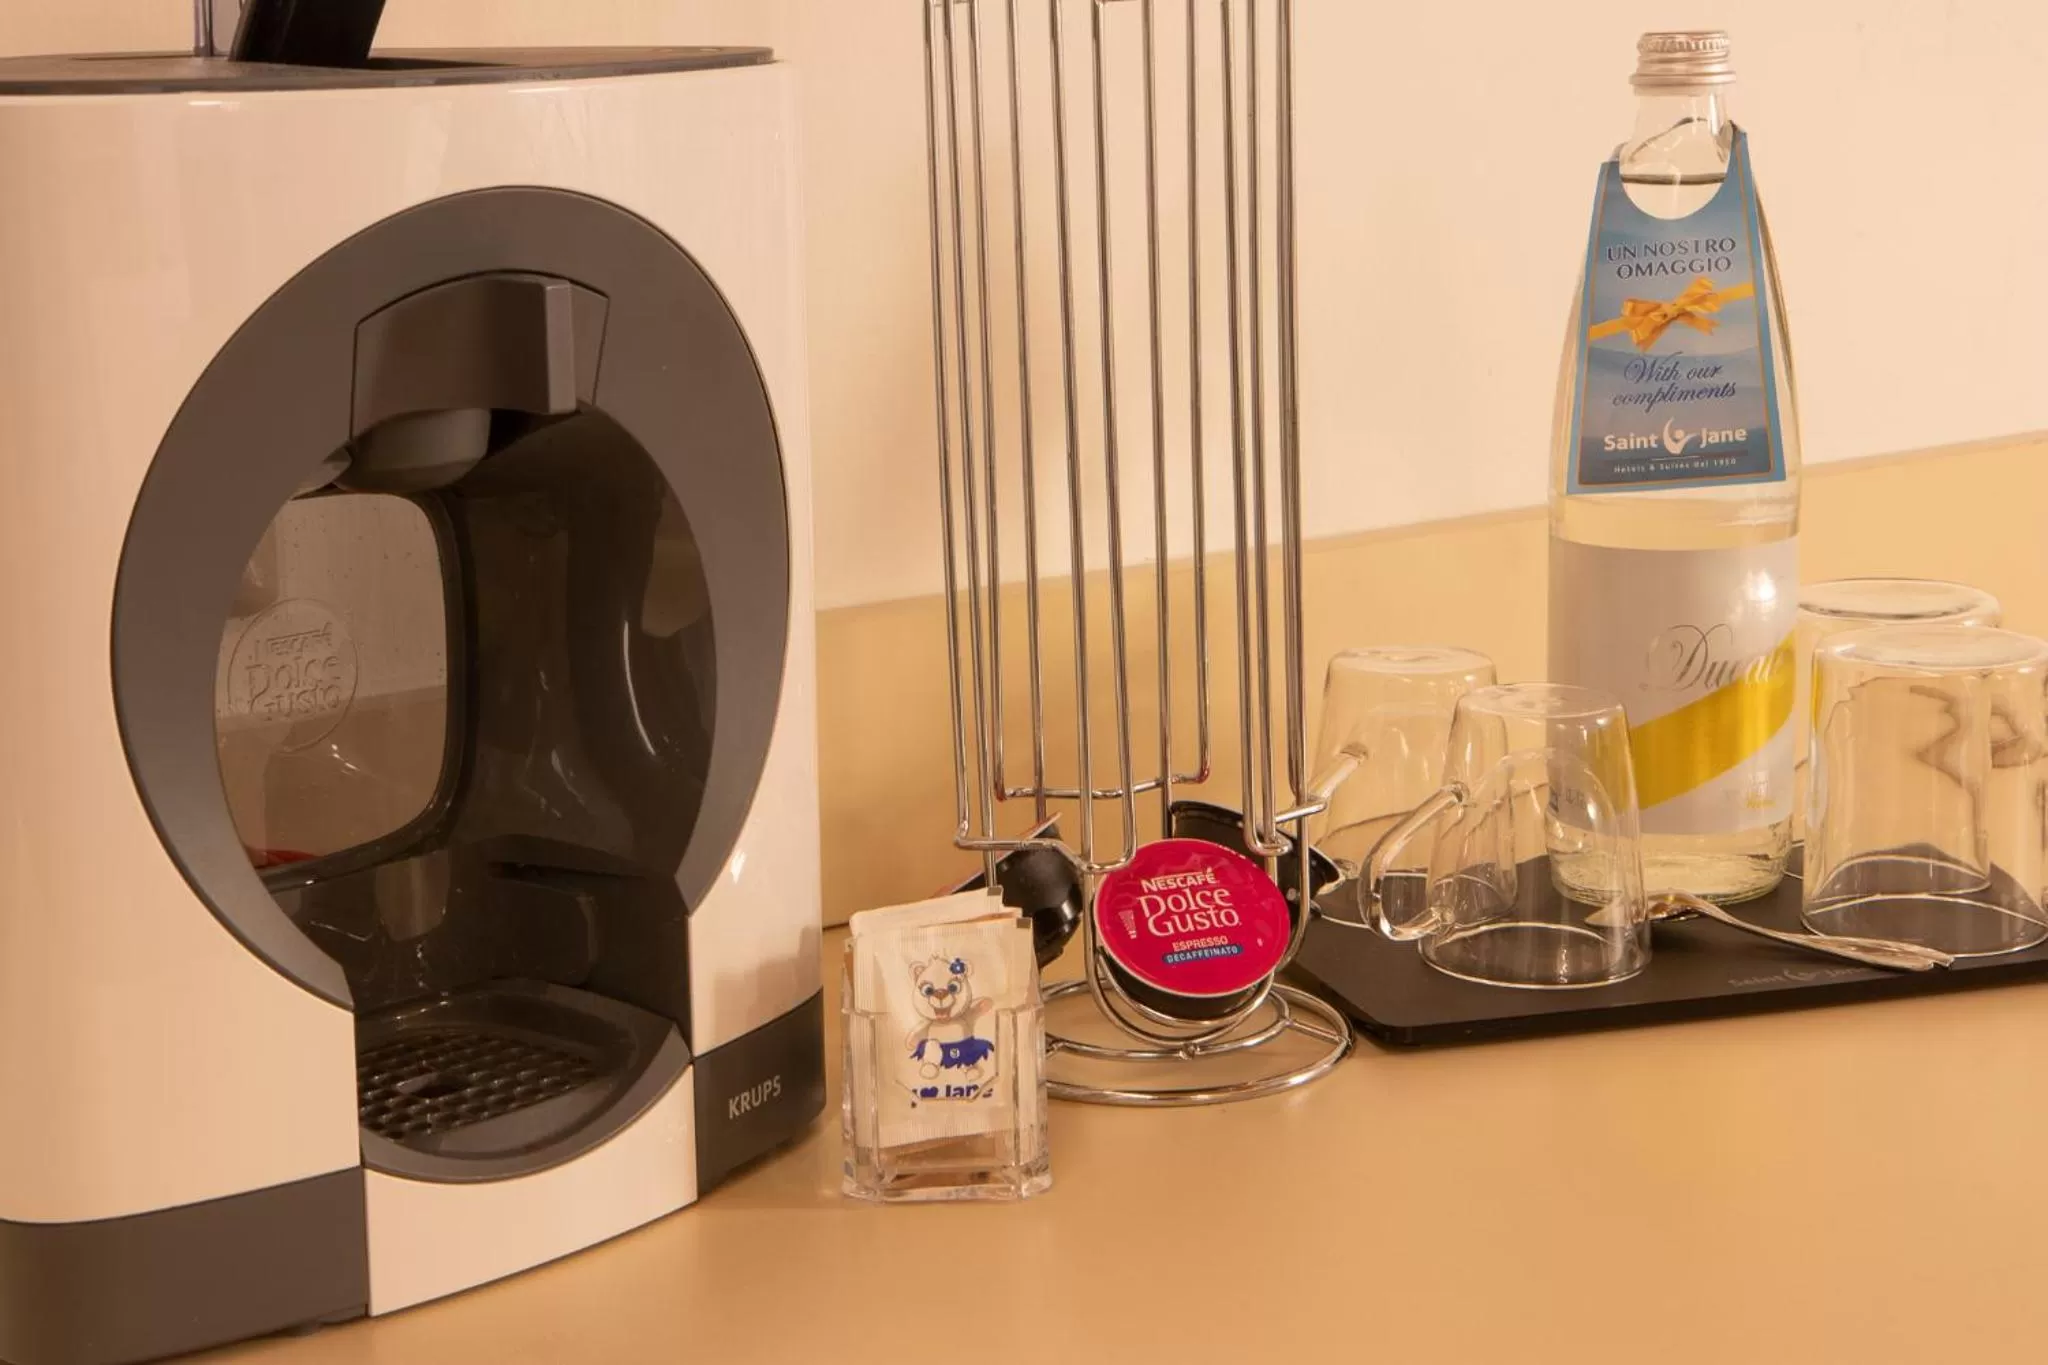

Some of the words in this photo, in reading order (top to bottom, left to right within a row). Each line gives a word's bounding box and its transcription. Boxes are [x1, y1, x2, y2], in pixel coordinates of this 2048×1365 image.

[1607, 241, 1637, 262] UN
[1643, 237, 1736, 259] NOSTRO
[1616, 255, 1732, 280] OMAGGIO
[1624, 351, 1684, 384] With
[1686, 364, 1723, 381] our
[1611, 381, 1737, 414] compliments
[1603, 433, 1659, 452] Saint
[1700, 426, 1748, 449] Jane
[245, 656, 340, 704] Dolce
[1140, 867, 1217, 893] NESCAFÉ
[1136, 887, 1233, 919] Dolce
[1147, 906, 1240, 937] Gusto
[1167, 946, 1239, 963] DECAFFEINATO
[1172, 935, 1229, 952] ESPRESSO
[728, 1074, 782, 1120] KRUPS
